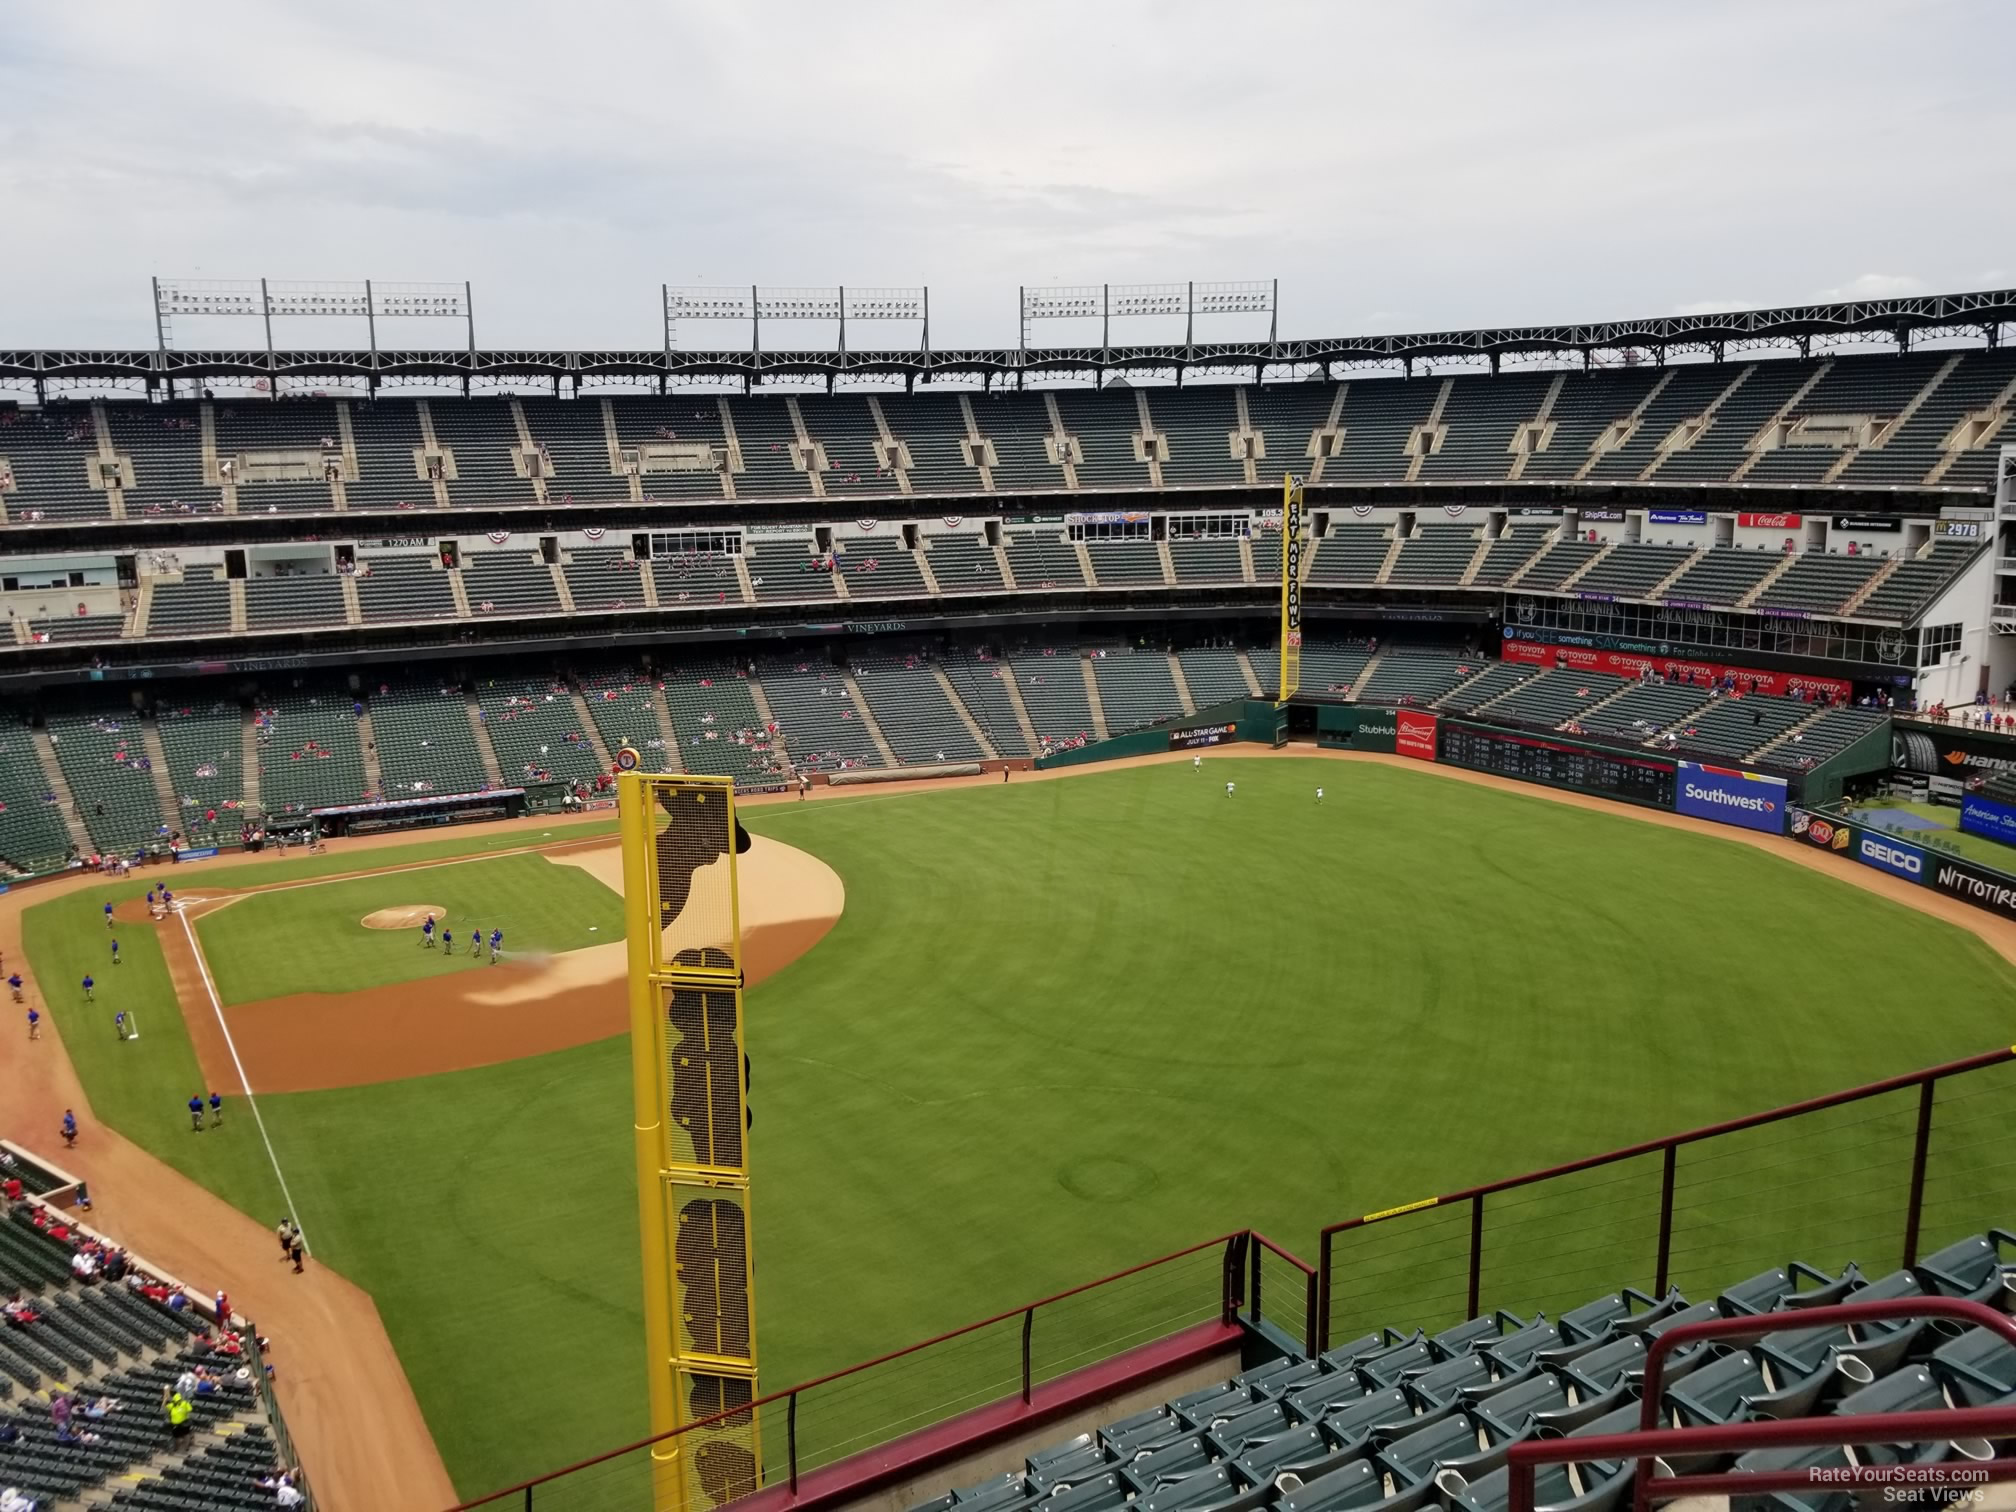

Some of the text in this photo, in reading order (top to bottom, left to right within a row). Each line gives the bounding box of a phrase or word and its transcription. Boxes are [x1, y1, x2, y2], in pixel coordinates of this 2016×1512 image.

[1068, 514, 1097, 523] SHOCK
[1948, 524, 1977, 536] 2978
[1289, 543, 1298, 576] MOR
[1289, 583, 1297, 627] FOWL
[1561, 600, 1583, 612] JACK
[1657, 608, 1682, 622] JACK
[848, 623, 906, 632] VINEYARDS
[1765, 618, 1792, 632] JACK
[1535, 629, 1557, 643] SEE
[1559, 635, 1592, 646] something
[1596, 636, 1619, 649] SAY
[1619, 642, 1656, 653] something
[1518, 644, 1545, 654] TOYOTA
[1568, 651, 1597, 661] TOYOTA
[1621, 657, 1652, 667] TOYOTA
[232, 658, 308, 671] VINEYARDS
[1678, 665, 1711, 675] TOYOTA
[1738, 672, 1774, 684] TOYOTA
[1804, 680, 1840, 693] TOYOTA
[1209, 726, 1228, 735] GAME
[1359, 724, 1396, 735] StubHub
[1685, 783, 1763, 812] Southwest
[1964, 804, 2000, 823] American
[1812, 828, 1830, 838] DQ
[1861, 839, 1921, 873] GEICO
